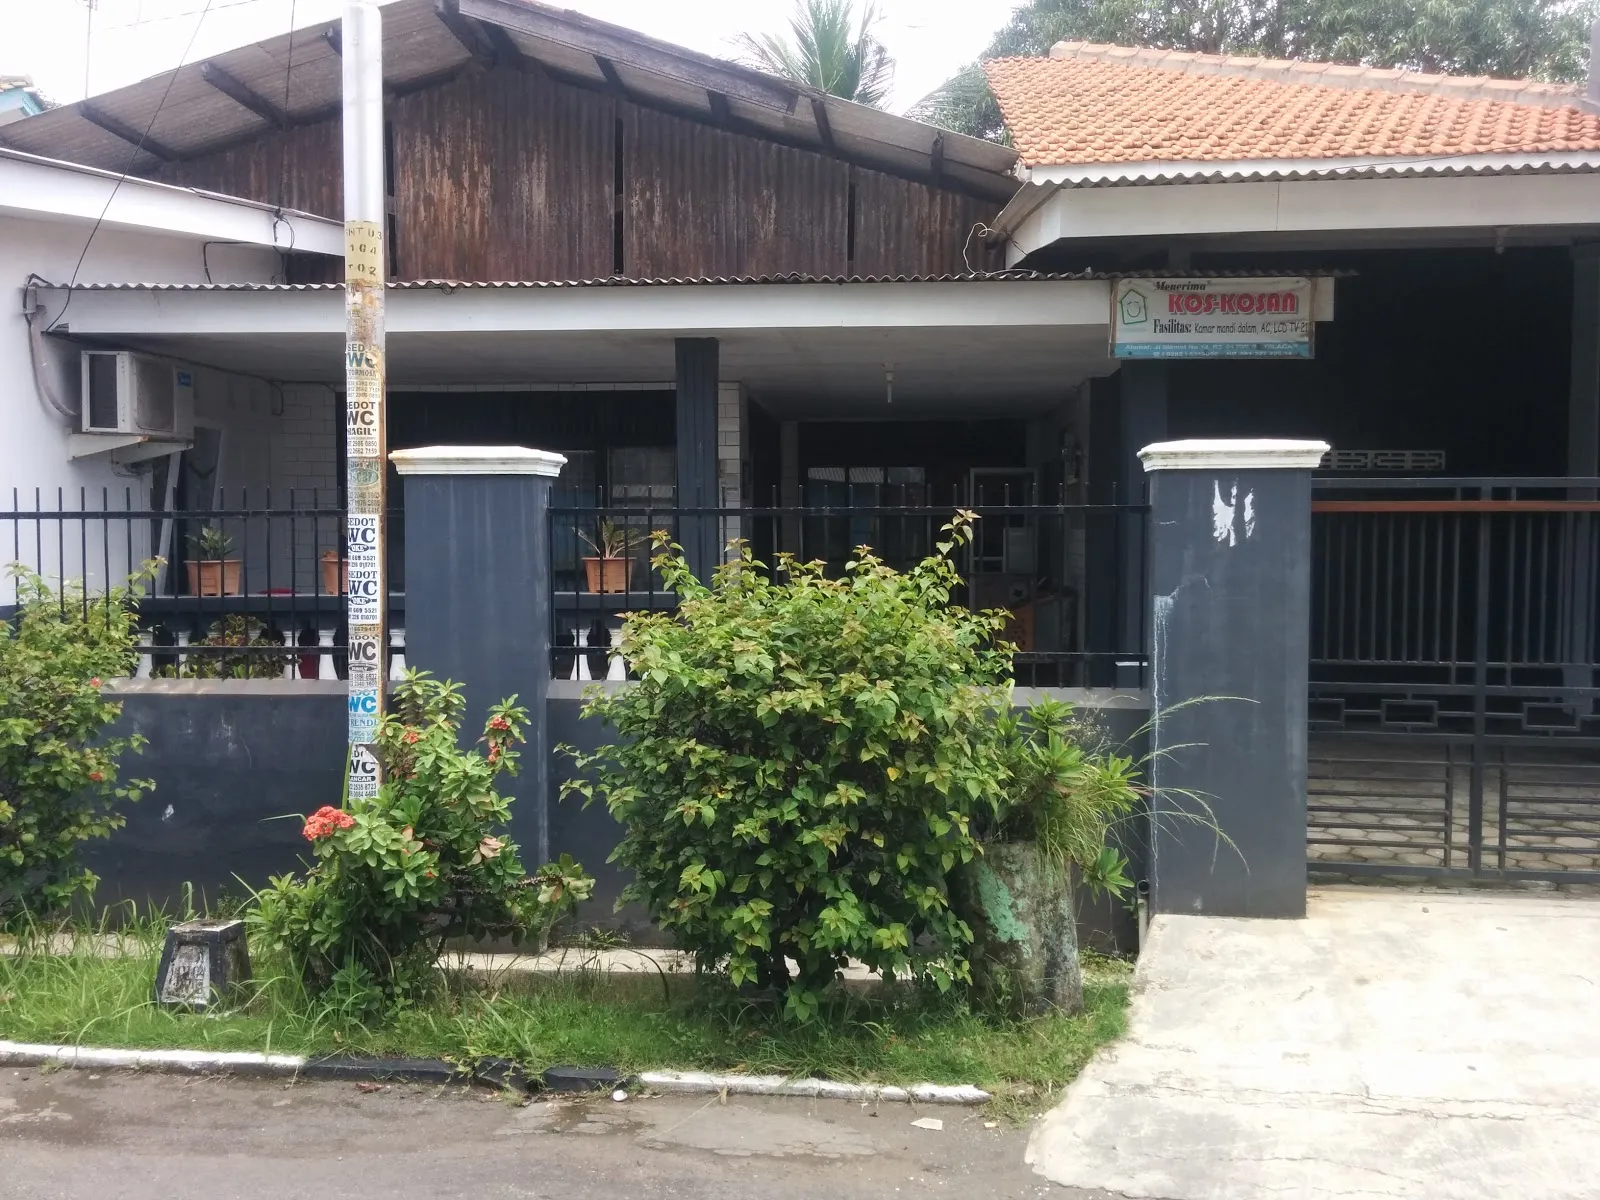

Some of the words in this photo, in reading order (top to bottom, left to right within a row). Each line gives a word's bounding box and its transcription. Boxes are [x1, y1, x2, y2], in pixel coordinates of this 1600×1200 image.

[1155, 281, 1206, 291] Menerima
[1168, 292, 1297, 313] KOS-KOSAN
[1153, 319, 1191, 334] Fasilitas:
[1217, 322, 1236, 333] mandi
[347, 410, 374, 426] WC
[348, 527, 375, 543] WC
[348, 580, 377, 596] WC
[349, 641, 376, 661] WC
[349, 696, 377, 713] WC
[350, 759, 376, 774] WC
